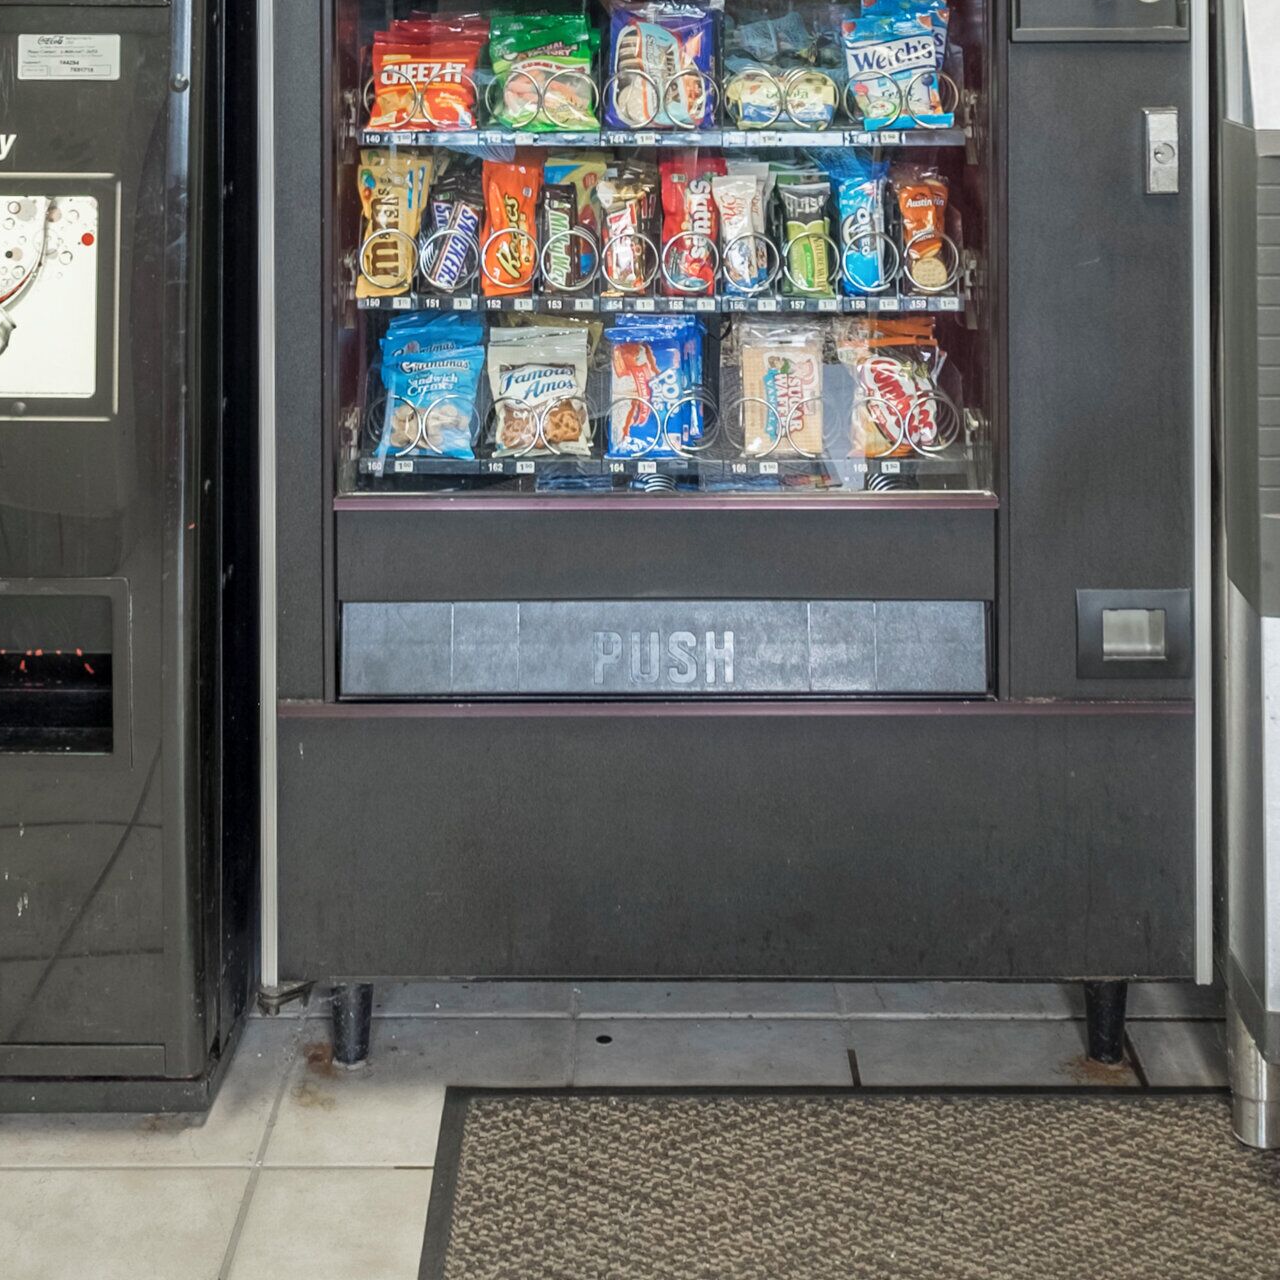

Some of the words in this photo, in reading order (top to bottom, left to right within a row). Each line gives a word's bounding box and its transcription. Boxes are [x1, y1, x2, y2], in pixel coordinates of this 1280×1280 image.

[905, 198, 933, 208] Austin
[689, 179, 711, 260] Skittles
[365, 298, 380, 307] 150
[425, 298, 440, 307] 151
[486, 299, 502, 308] 152
[547, 299, 562, 309] 153
[790, 300, 805, 309] 157
[504, 366, 576, 394] Famous
[523, 378, 577, 400] Amos
[787, 376, 803, 433] SUGAR
[592, 630, 735, 684] PUSH
